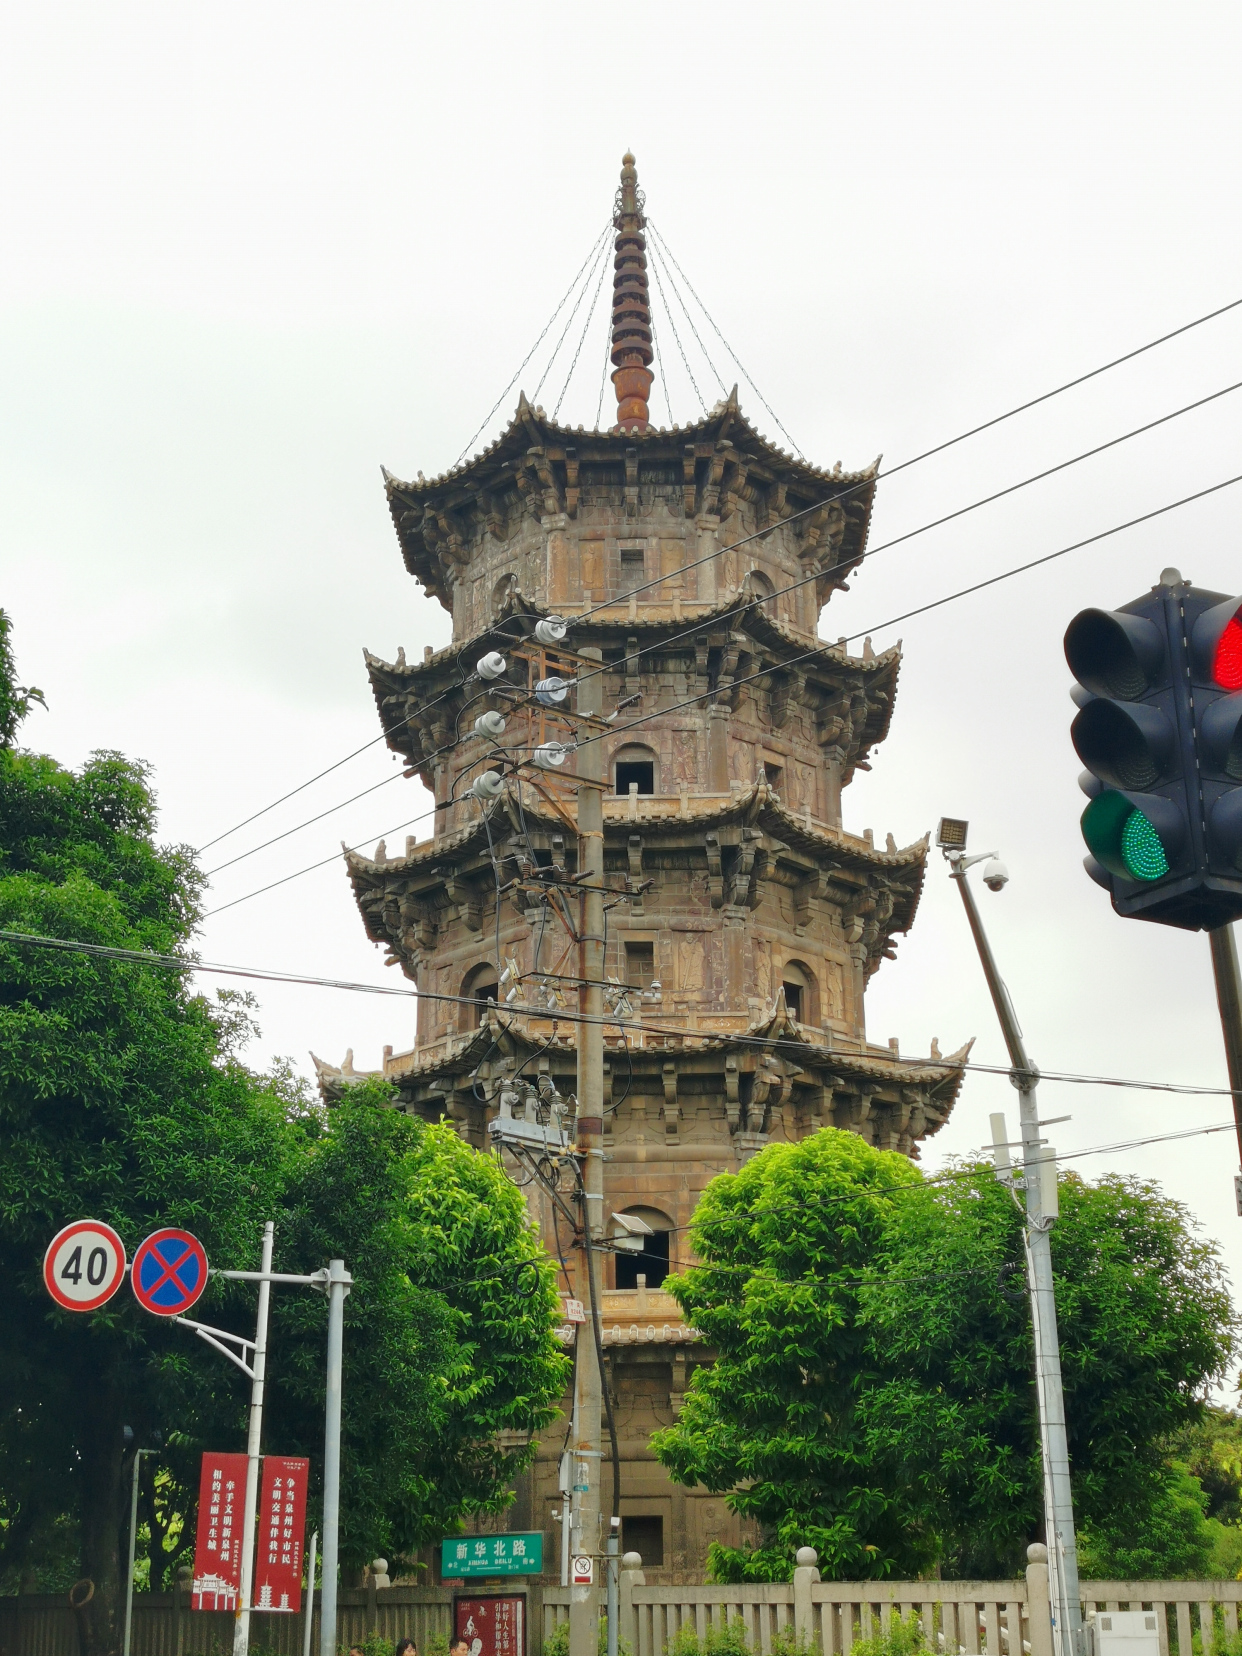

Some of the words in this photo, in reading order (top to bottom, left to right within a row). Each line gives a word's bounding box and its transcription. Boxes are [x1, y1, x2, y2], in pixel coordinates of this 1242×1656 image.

[61, 1245, 108, 1286] 40
[207, 1469, 222, 1551] 相约美丽卫生城
[220, 1480, 235, 1562] 牵手文明新泉州
[268, 1477, 282, 1564] 文明交通伴我行
[282, 1477, 295, 1564] 争当泉州好市民
[456, 1539, 527, 1560] 新华北路
